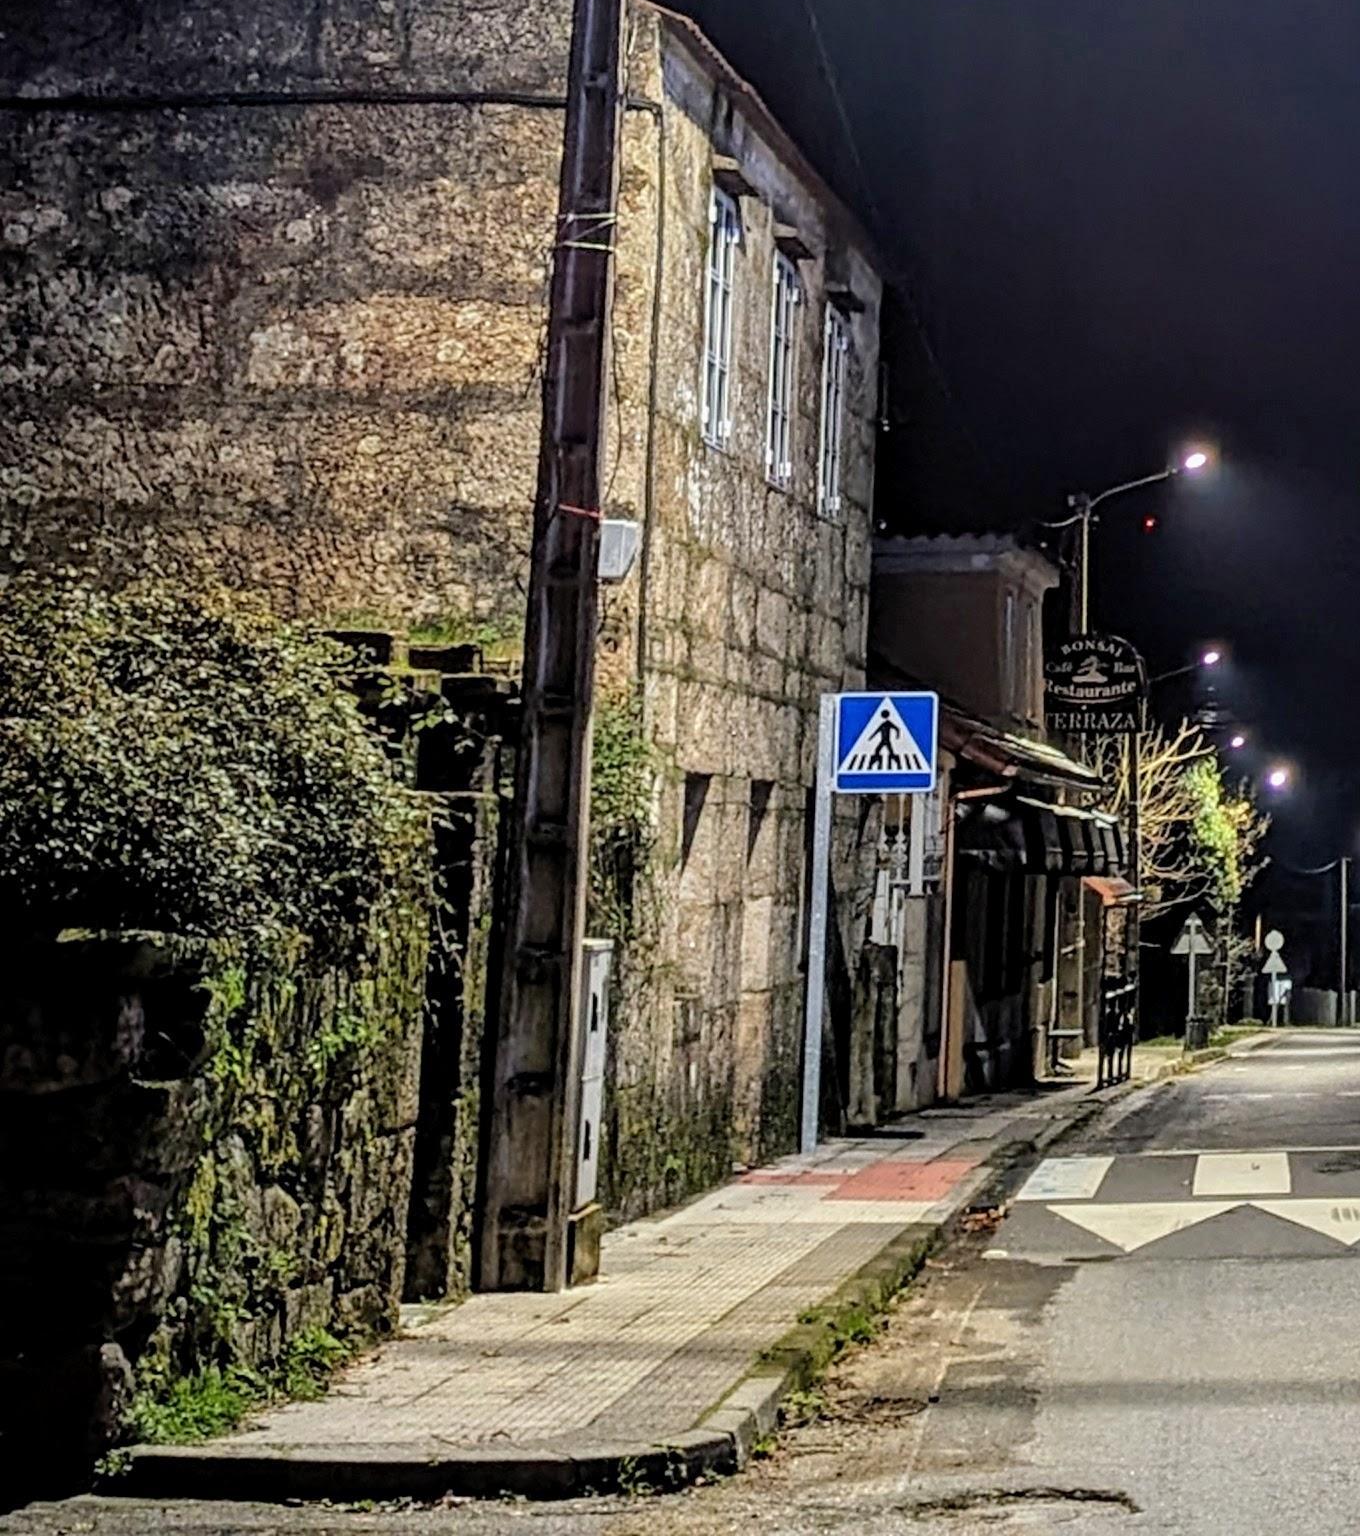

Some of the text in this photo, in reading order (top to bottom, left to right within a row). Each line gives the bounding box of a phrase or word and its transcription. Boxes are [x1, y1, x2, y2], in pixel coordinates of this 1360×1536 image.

[1061, 639, 1123, 658] BONSAI
[1113, 662, 1137, 673] Bar
[1045, 712, 1136, 729] TERRAZA
